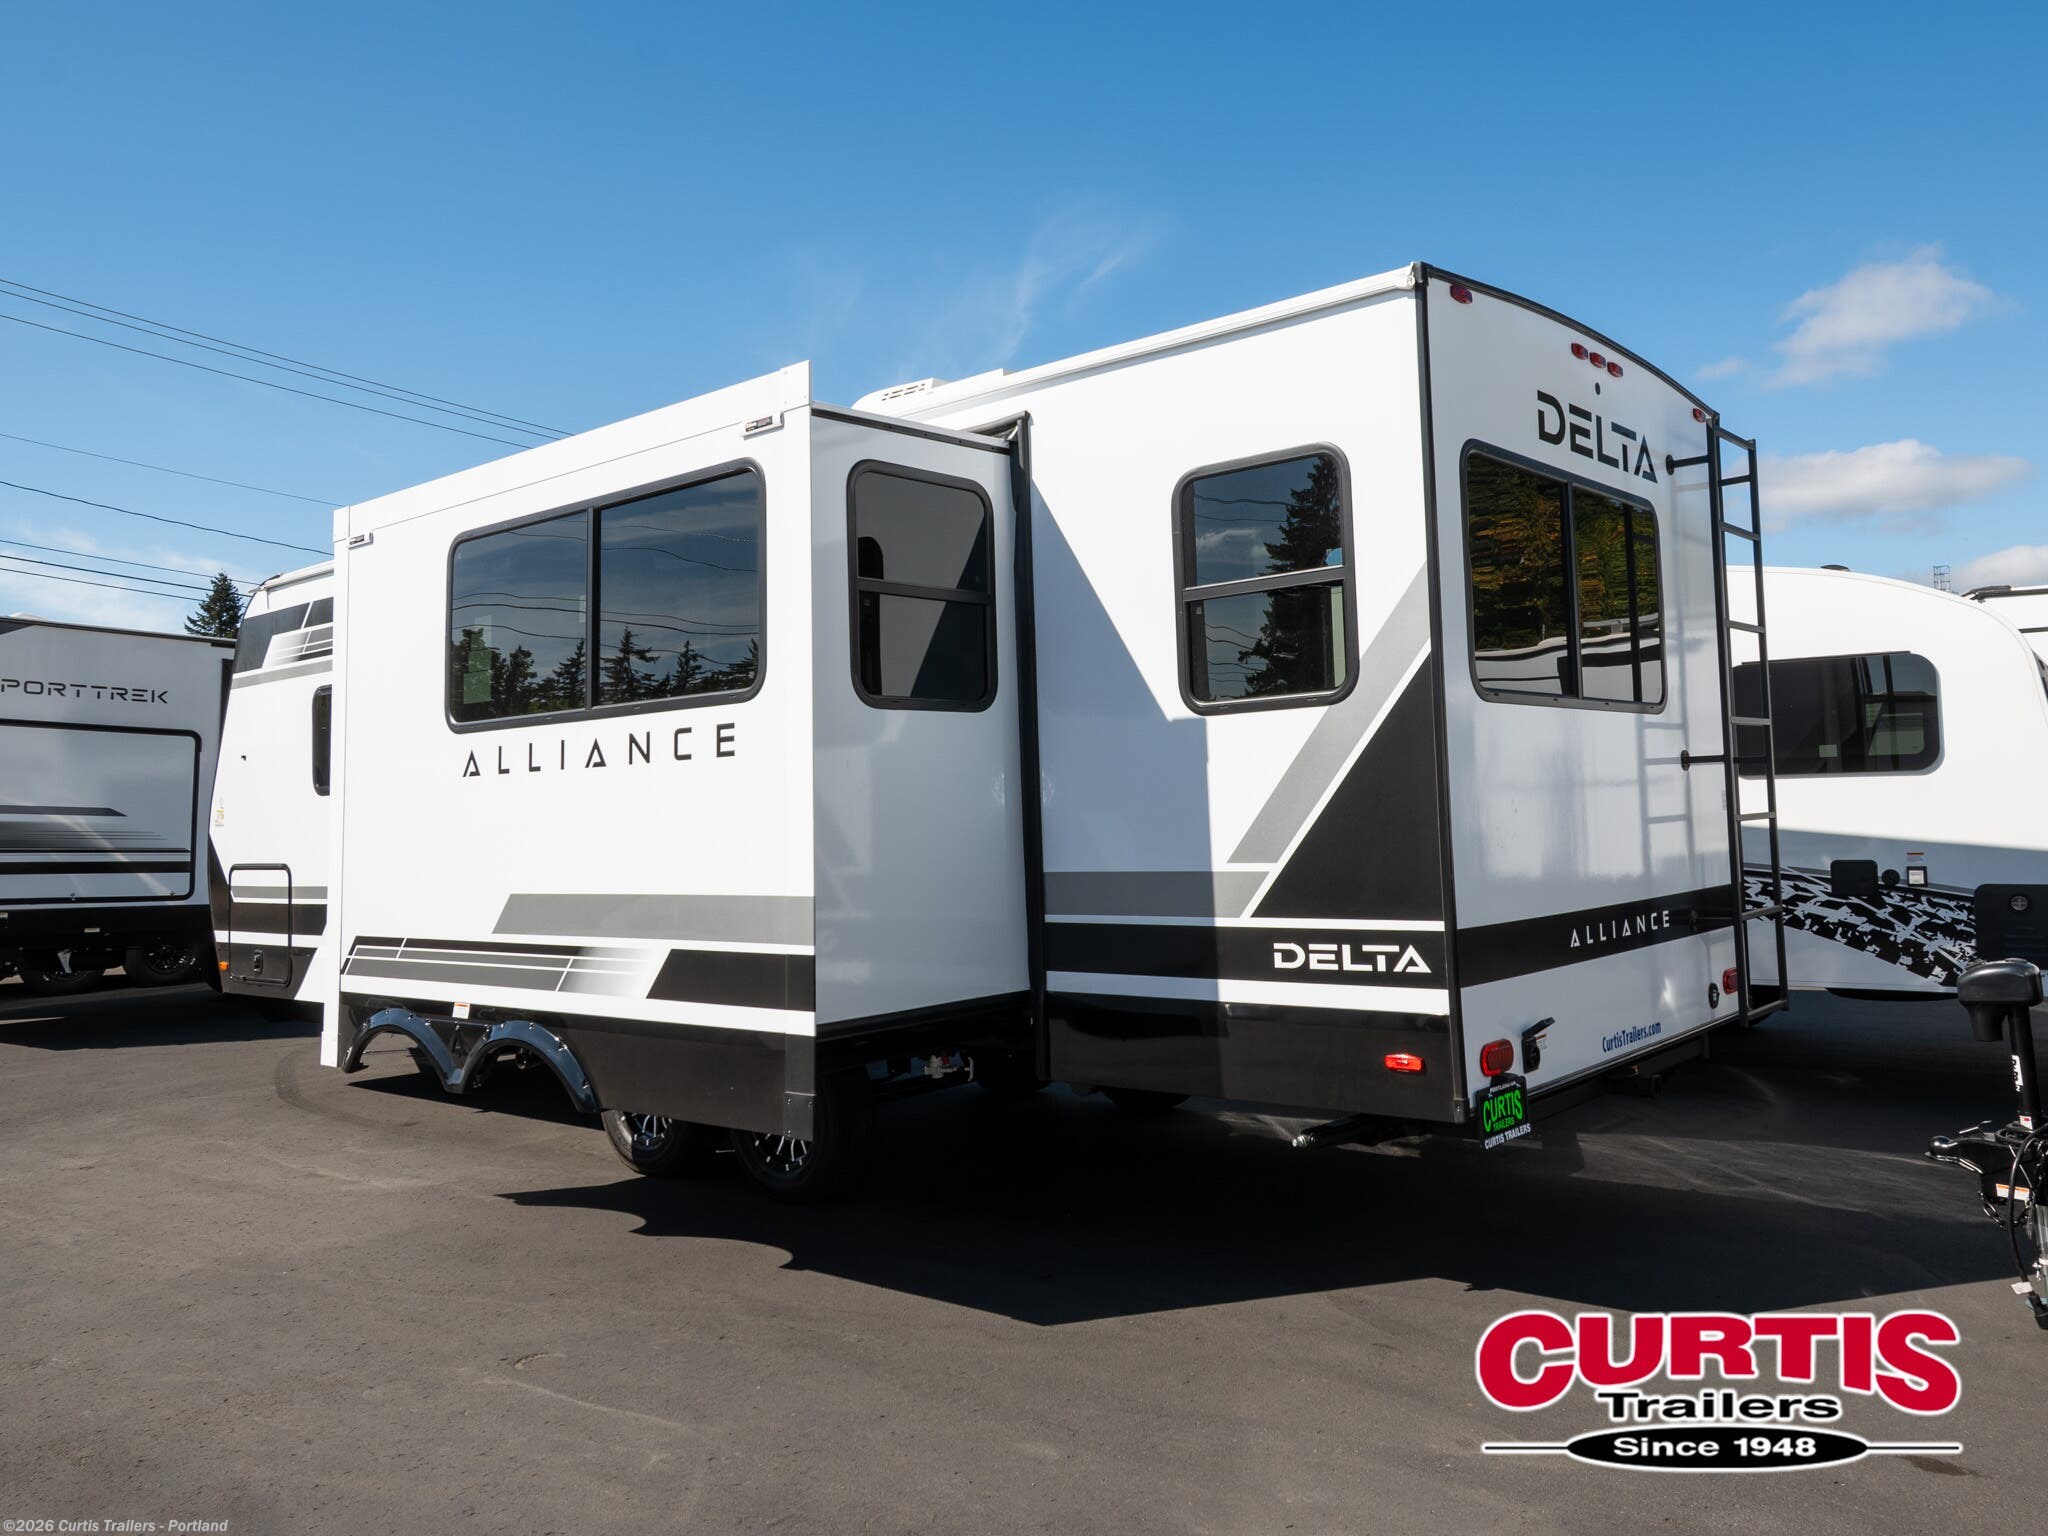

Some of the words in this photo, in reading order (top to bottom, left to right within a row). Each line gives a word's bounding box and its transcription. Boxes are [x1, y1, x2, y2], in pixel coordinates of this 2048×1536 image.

[1537, 389, 1658, 484] DELTA
[462, 722, 736, 778] ALLIANCE
[1570, 909, 1671, 949] ALLIANCE
[1273, 942, 1432, 974] DELTA
[1602, 1021, 1662, 1053] CurtisTrailers.com
[1483, 1089, 1523, 1133] CURTIS
[1484, 1133, 1505, 1150] CURTIS
[1504, 1123, 1532, 1141] TRAILERS
